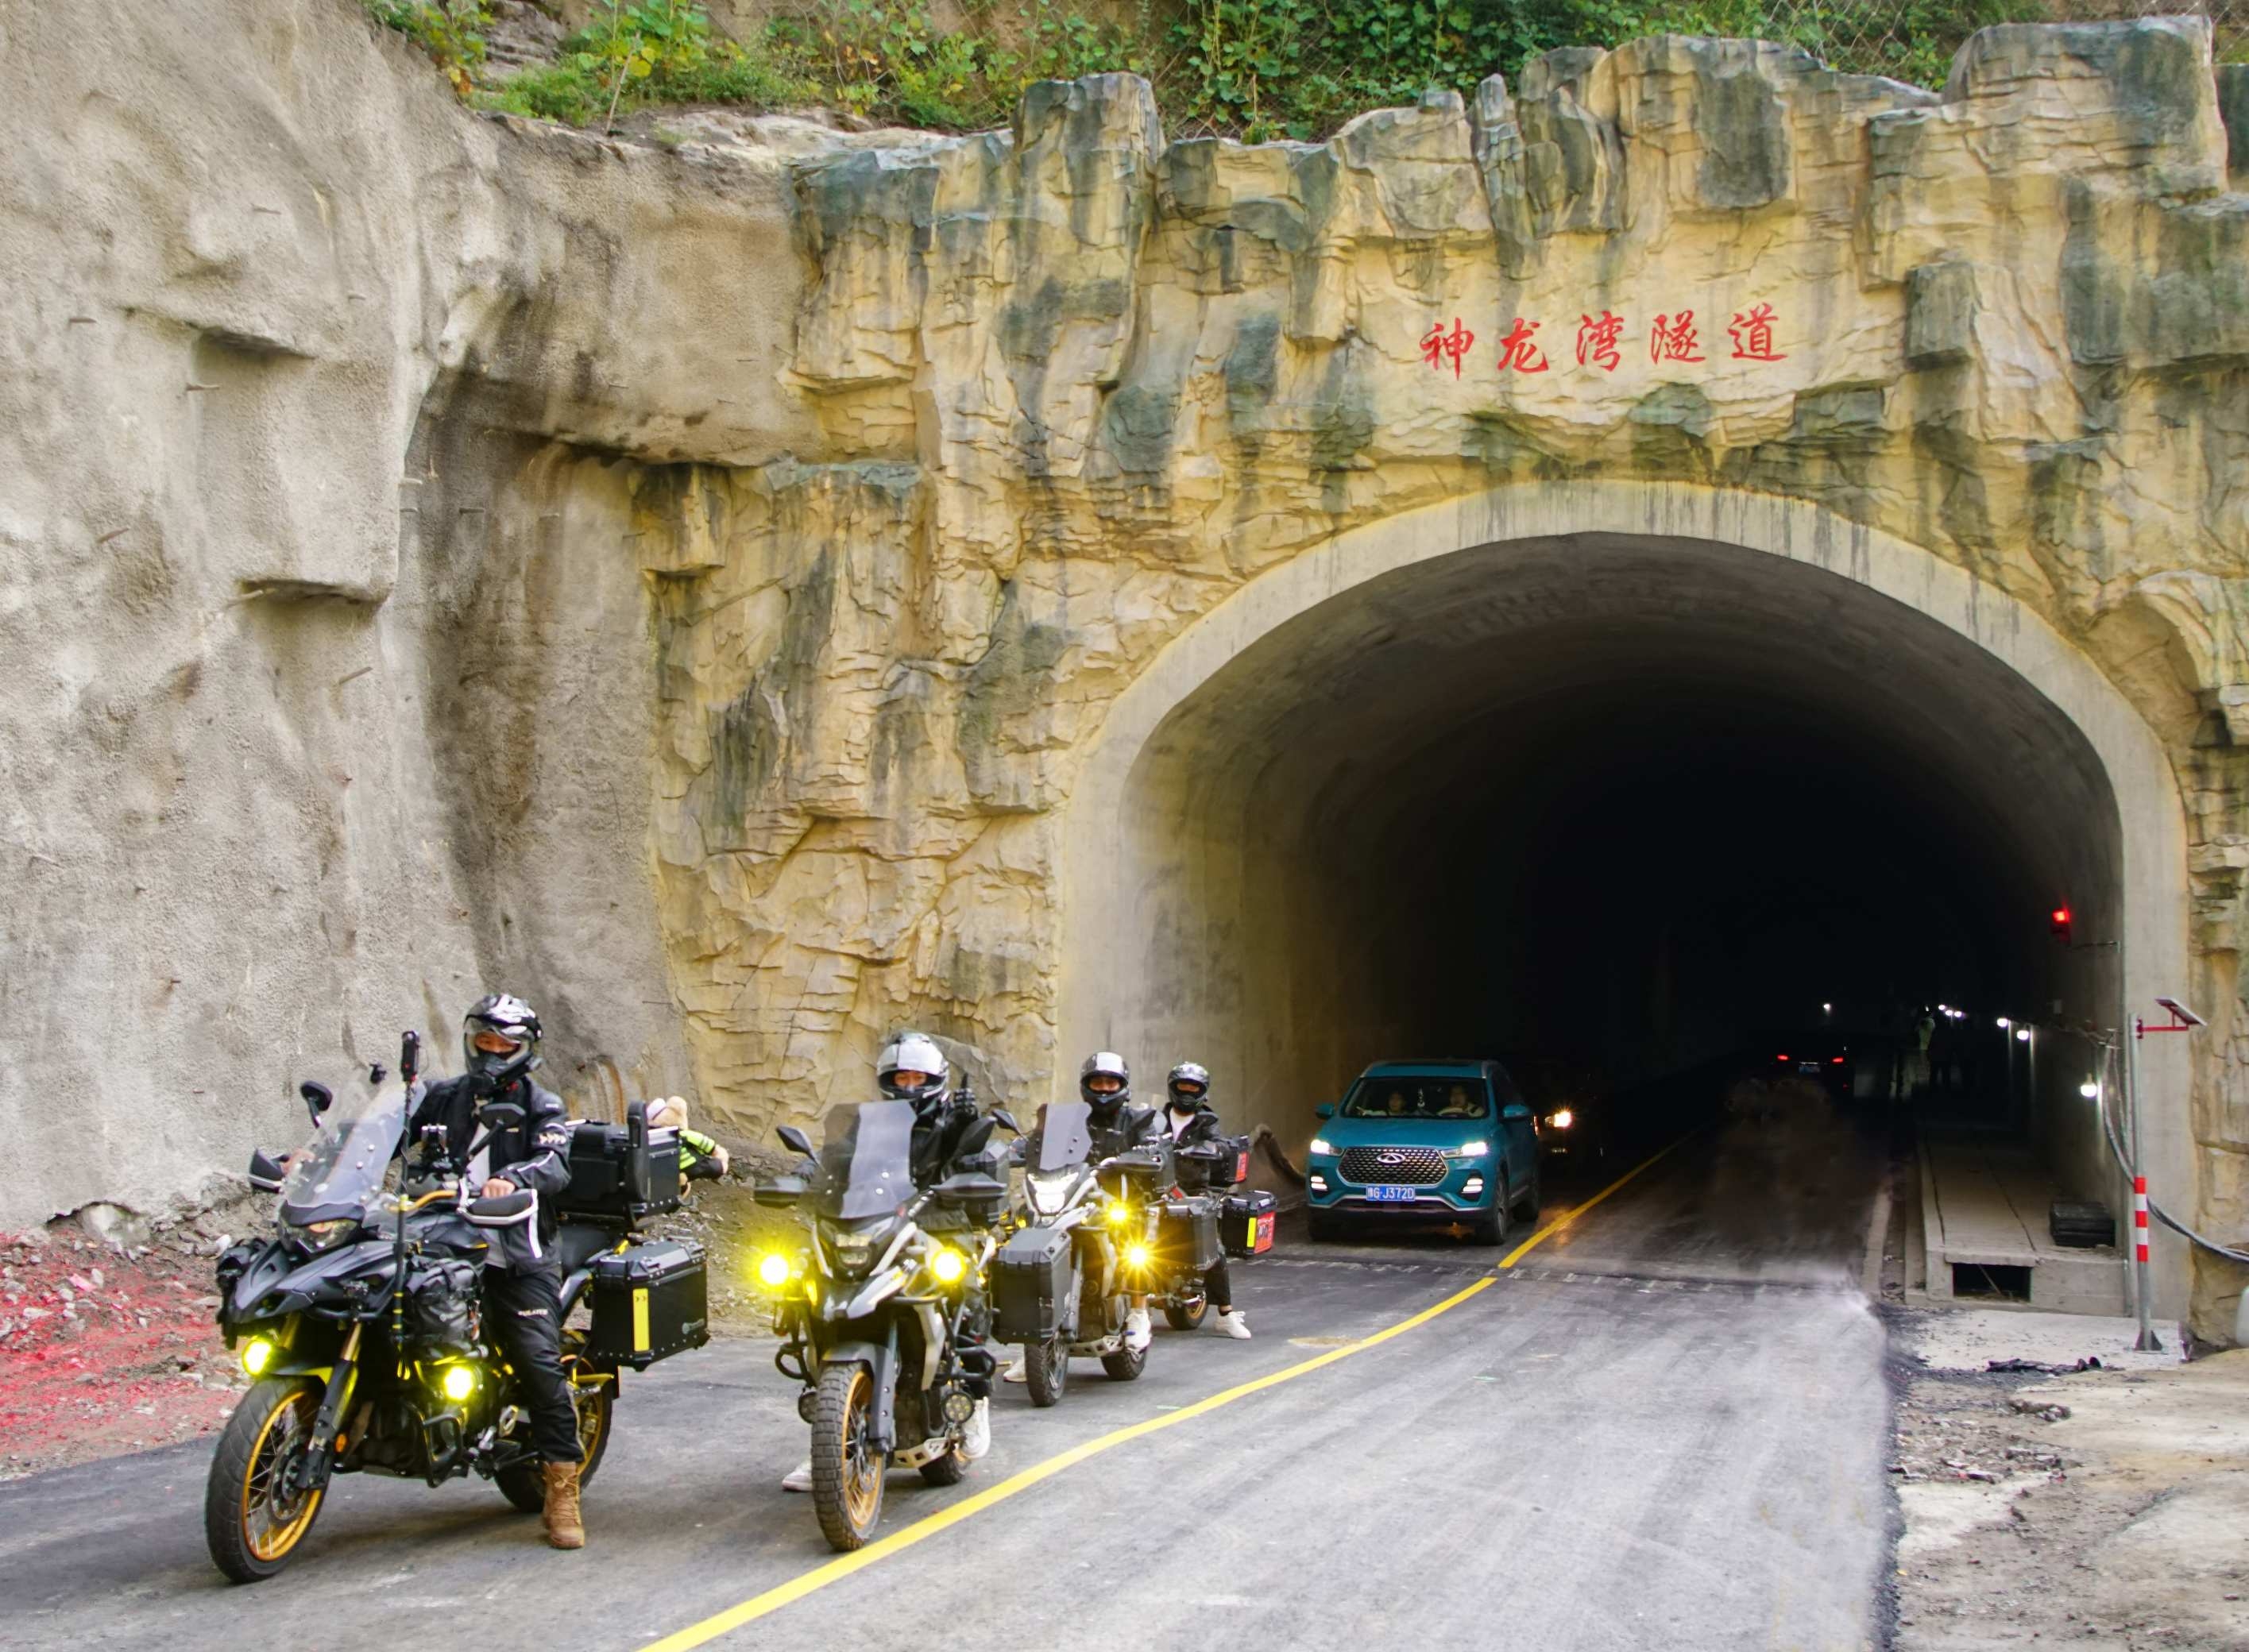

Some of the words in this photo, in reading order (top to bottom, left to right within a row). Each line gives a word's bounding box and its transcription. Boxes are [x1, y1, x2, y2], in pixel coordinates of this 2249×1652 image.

[1420, 303, 1788, 380] 神龙湾隧道
